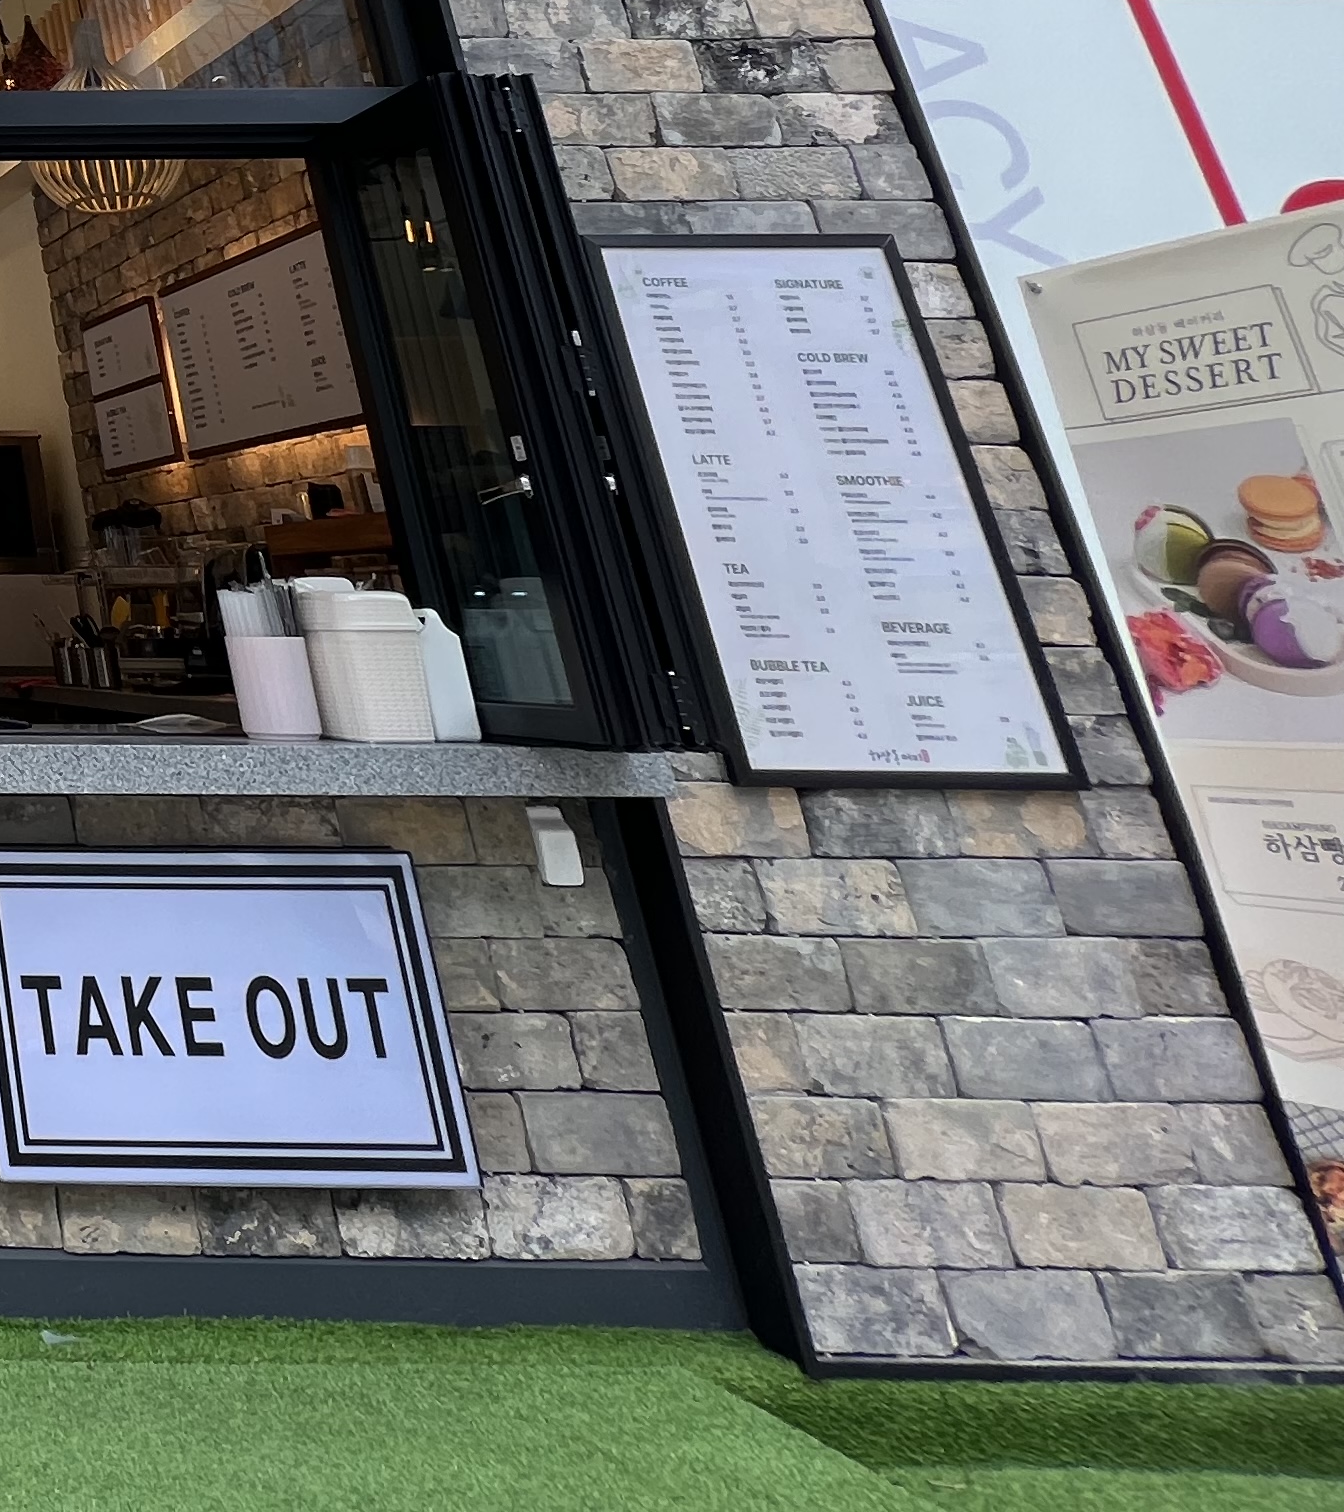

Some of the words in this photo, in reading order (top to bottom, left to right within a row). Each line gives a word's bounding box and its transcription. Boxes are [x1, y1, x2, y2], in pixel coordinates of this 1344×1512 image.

[642, 277, 688, 288] COFFEE
[774, 278, 844, 290] SIGNATURE
[1102, 344, 1151, 375] MY
[1159, 321, 1273, 365] SWEET
[797, 352, 831, 363] COLD
[833, 353, 868, 364] BREW
[1110, 352, 1282, 404] DESSERT
[692, 454, 732, 466] LATTE
[836, 475, 905, 488] SMOOTHIE
[722, 562, 750, 575] TEA
[881, 621, 952, 635] BEVERAGE
[750, 659, 799, 672] BUBBLE
[803, 660, 830, 674] TEA
[906, 695, 945, 708] JUICE
[20, 975, 225, 1058] TAKE
[246, 975, 389, 1060] OUT
